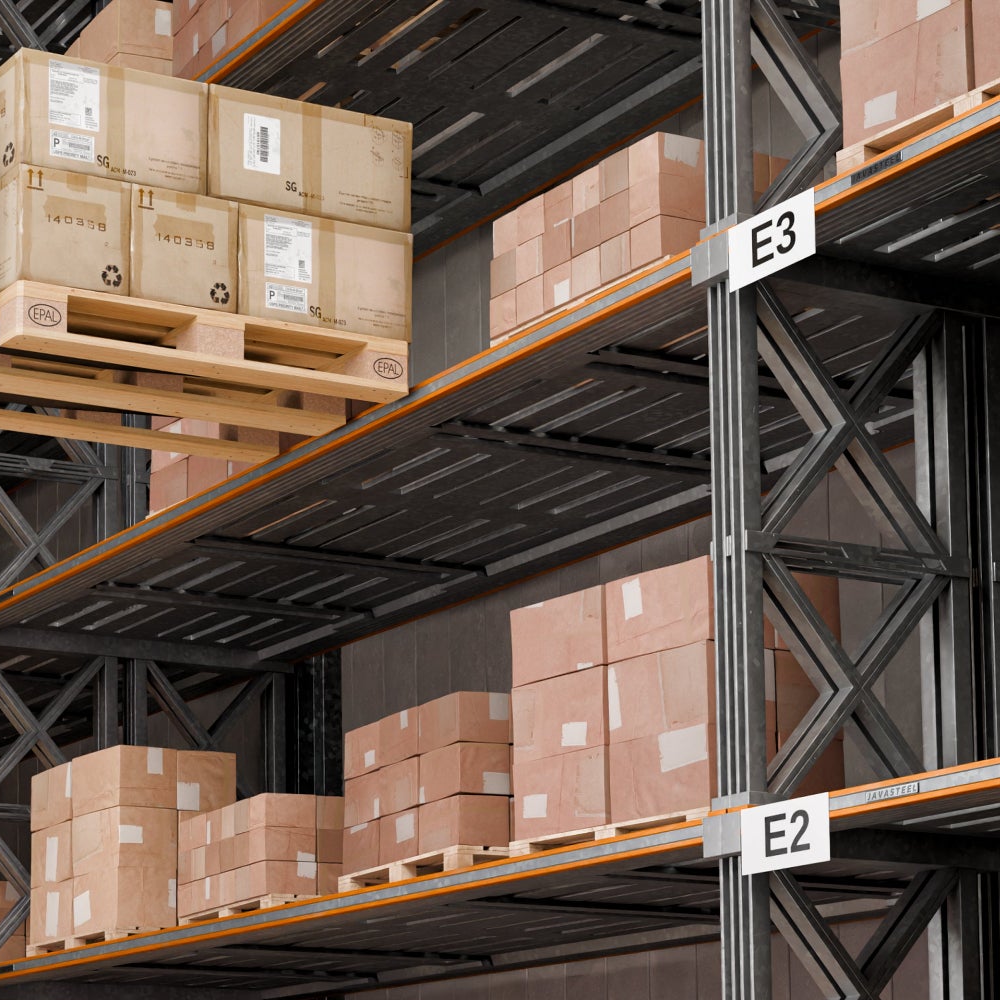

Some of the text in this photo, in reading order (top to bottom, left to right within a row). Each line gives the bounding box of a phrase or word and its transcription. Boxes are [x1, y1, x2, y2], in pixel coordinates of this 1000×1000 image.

[53, 137, 60, 147] P
[97, 154, 109, 168] SG
[286, 180, 297, 192] SG
[47, 213, 106, 232] 140358
[157, 232, 215, 250] 140358
[751, 210, 796, 268] E3
[269, 290, 275, 300] P
[33, 307, 57, 323] EPAL
[310, 305, 321, 319] SG
[378, 361, 399, 376] EPAL
[867, 783, 917, 801] JAVASTEEL
[764, 809, 811, 858] E2
